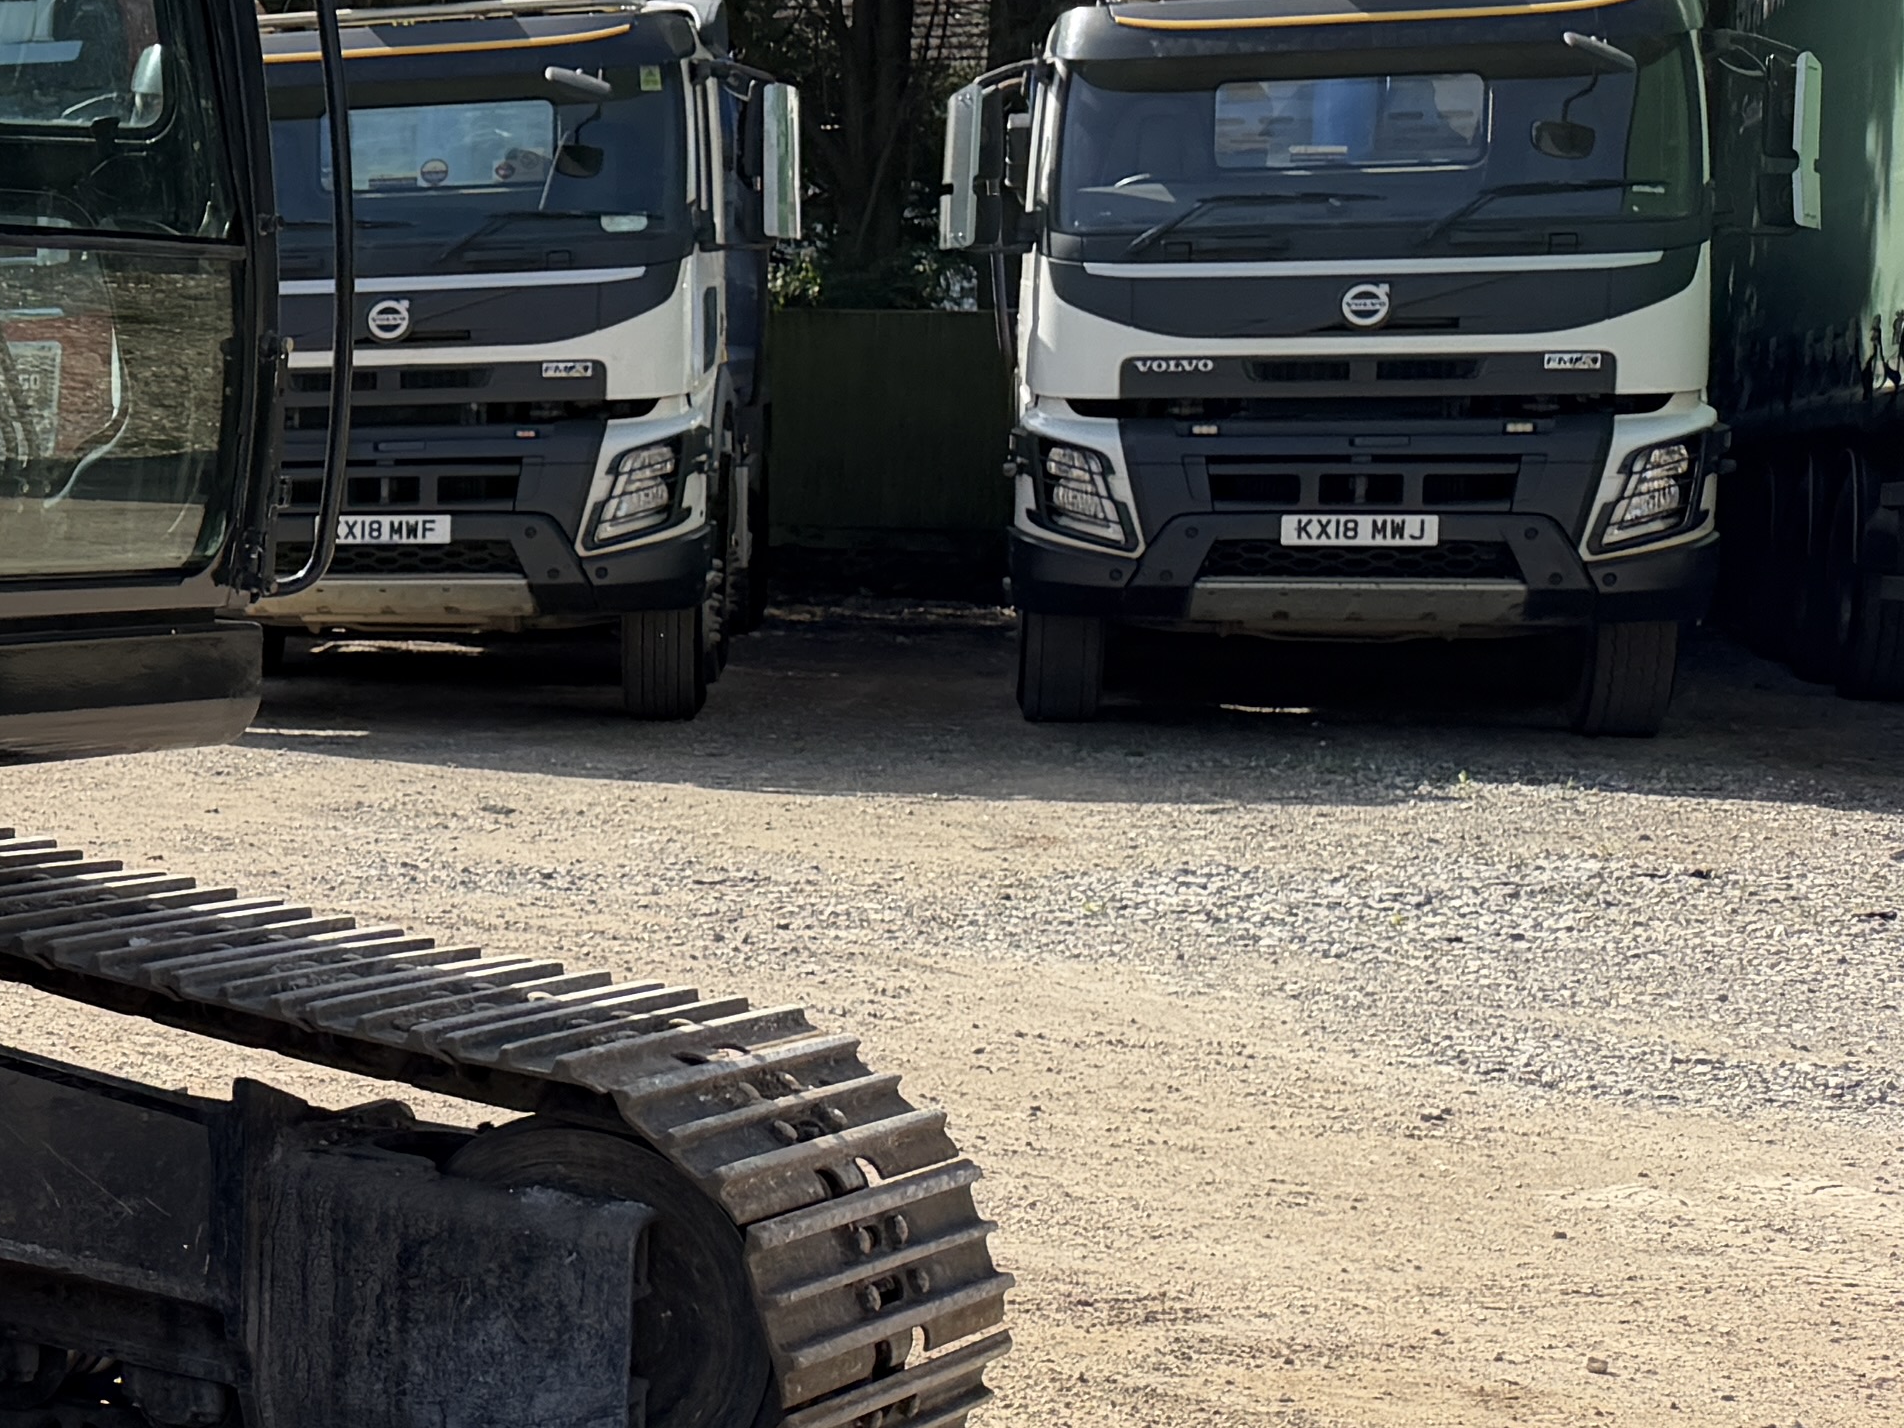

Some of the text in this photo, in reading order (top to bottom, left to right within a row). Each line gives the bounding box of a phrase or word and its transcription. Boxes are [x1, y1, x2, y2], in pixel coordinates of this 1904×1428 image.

[1134, 359, 1214, 372] VOLVO
[389, 519, 436, 540] MWF
[1294, 518, 1425, 541] KX18 MWJ
